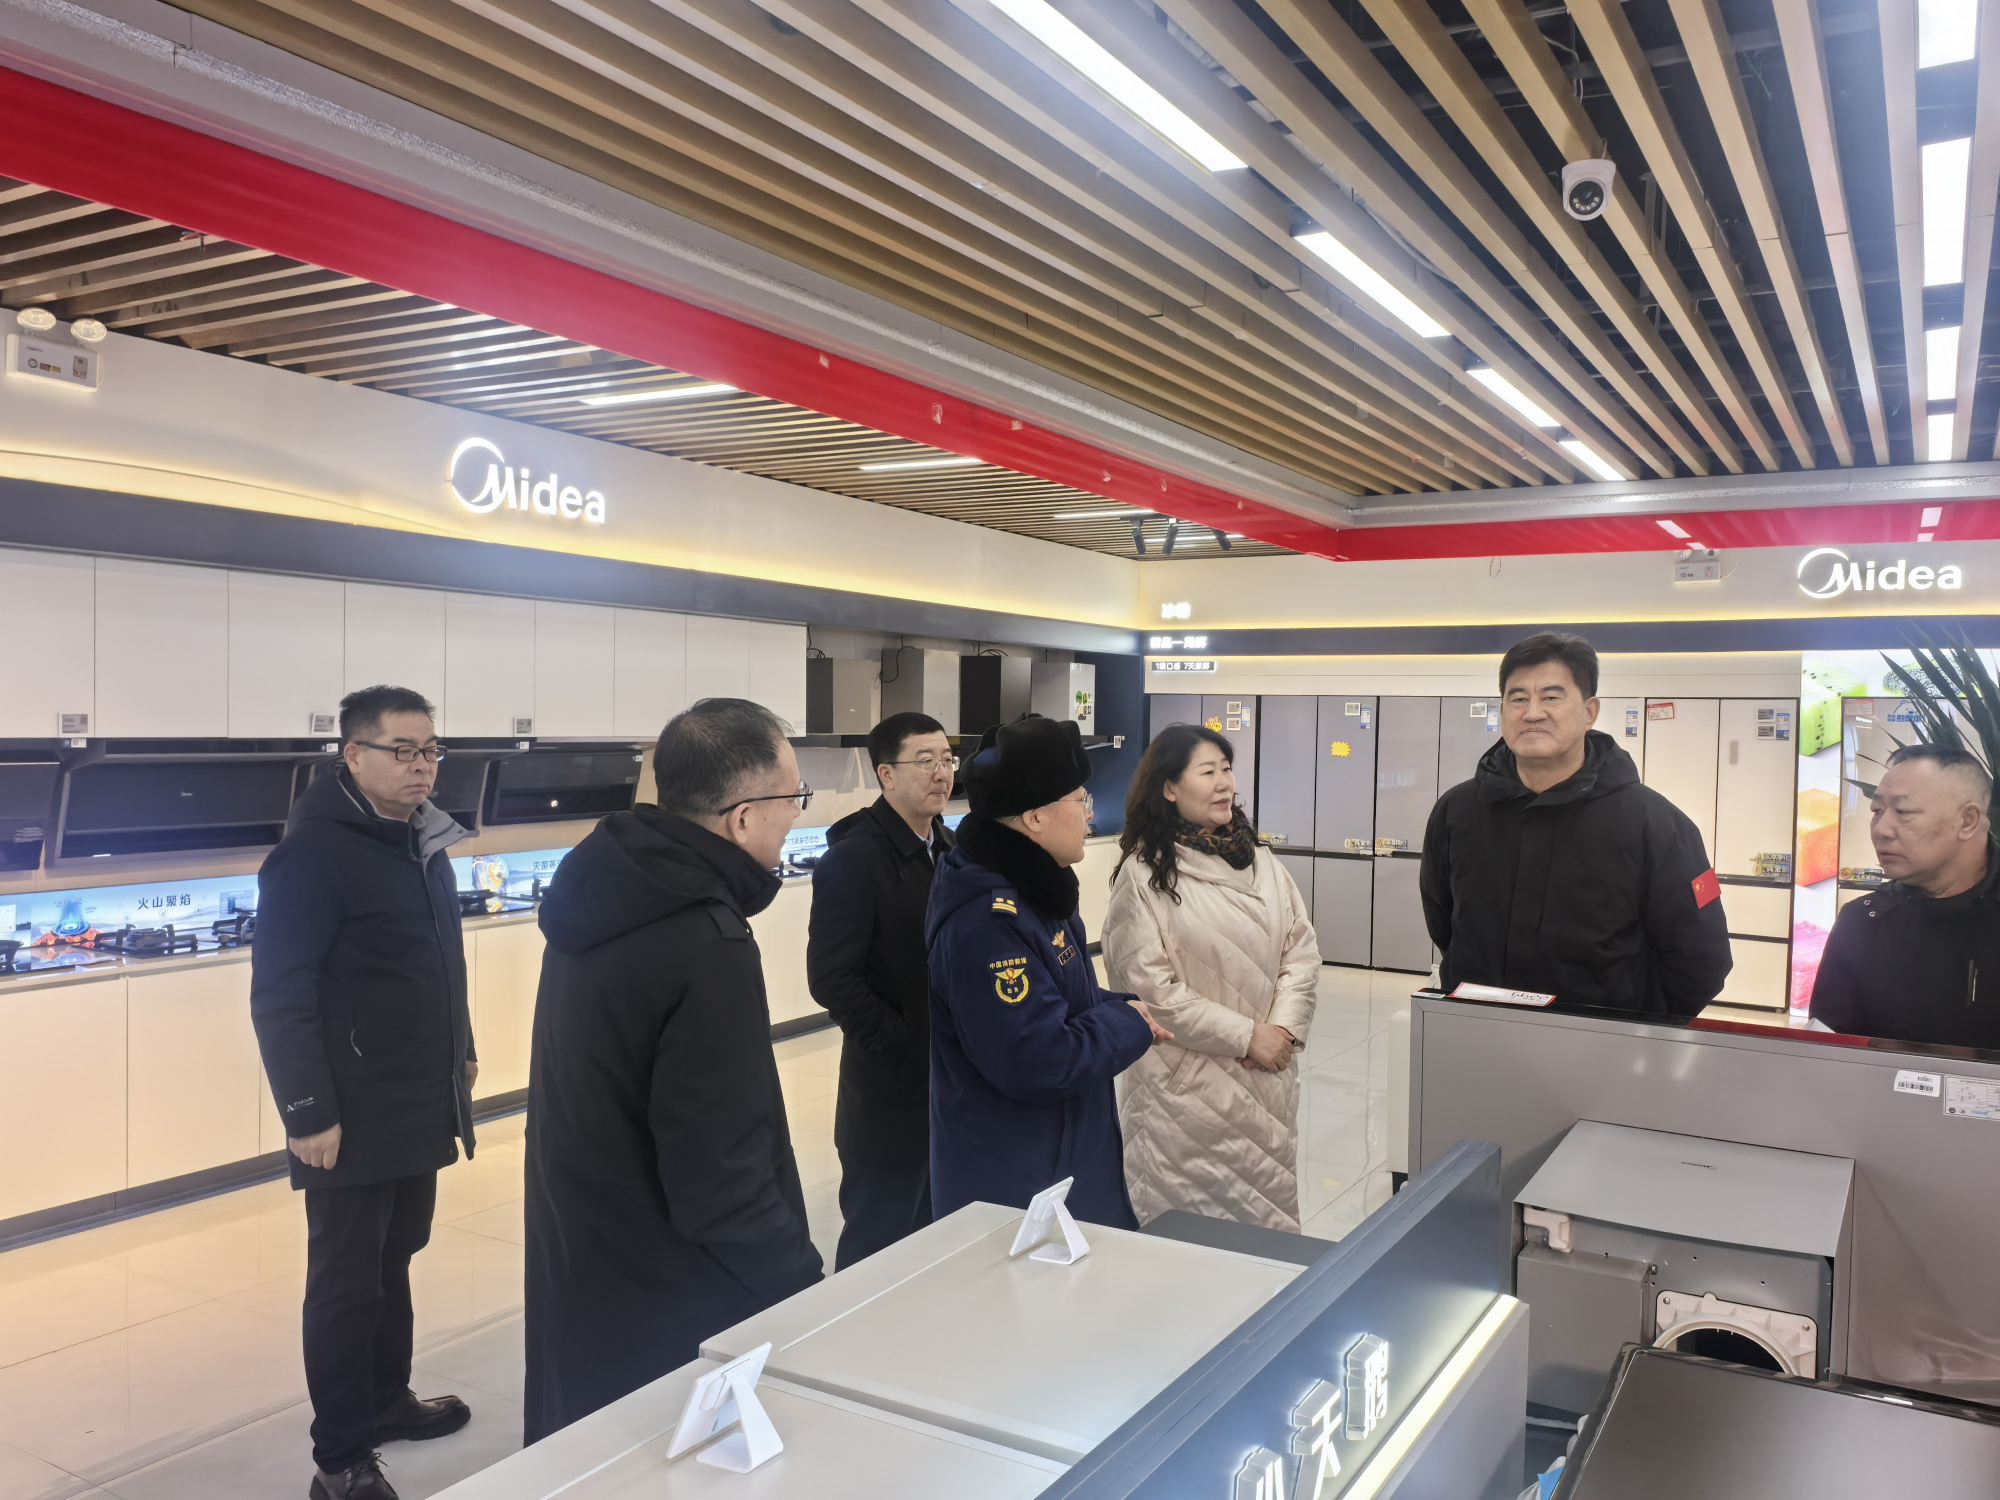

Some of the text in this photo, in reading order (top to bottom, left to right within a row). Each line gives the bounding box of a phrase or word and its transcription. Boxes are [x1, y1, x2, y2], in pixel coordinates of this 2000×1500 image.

[451, 437, 605, 523] Midea
[1798, 547, 1962, 599] Midea
[138, 894, 191, 910] 火山聚焰
